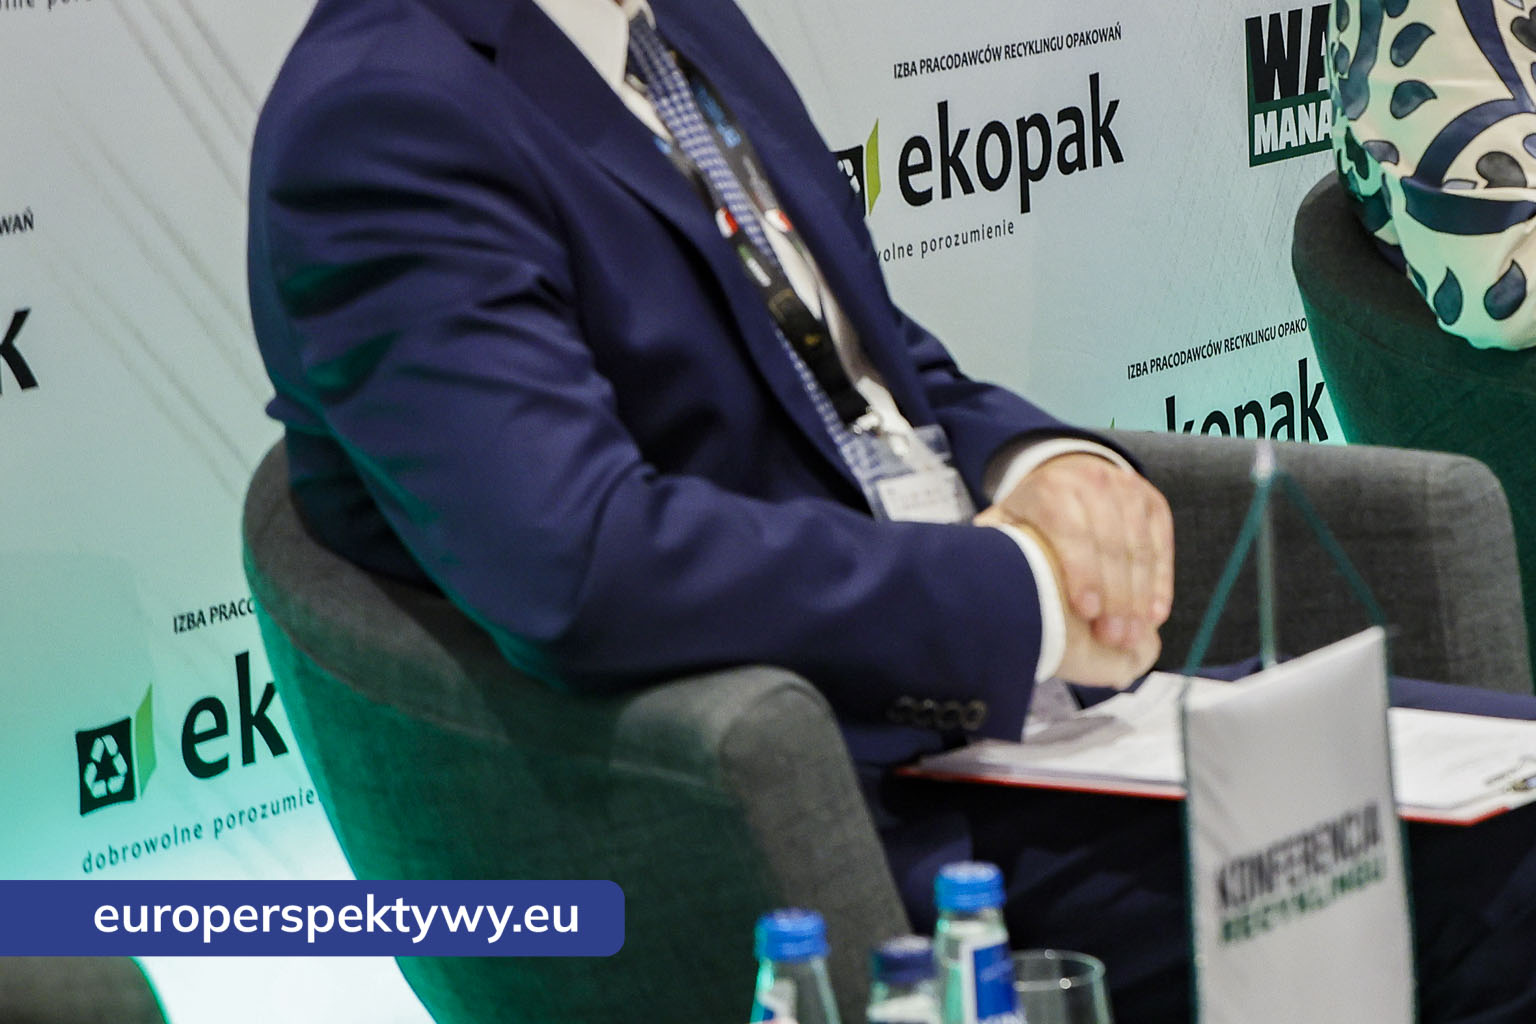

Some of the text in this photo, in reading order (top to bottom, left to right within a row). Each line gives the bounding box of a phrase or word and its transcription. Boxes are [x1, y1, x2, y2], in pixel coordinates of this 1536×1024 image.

[893, 21, 1122, 79] IZBA PRACODAWCÓW RECYKLINGU OPAKOWAŃ
[898, 72, 1125, 214] ekopak
[920, 219, 1015, 258] porozumienie
[1127, 362, 1149, 380] IZBA
[1150, 339, 1223, 374] PRACODAWCÓW
[1224, 326, 1277, 354] RECYKLINGU
[173, 609, 207, 635] IZBA
[82, 787, 321, 874] dobrowolne porozumie
